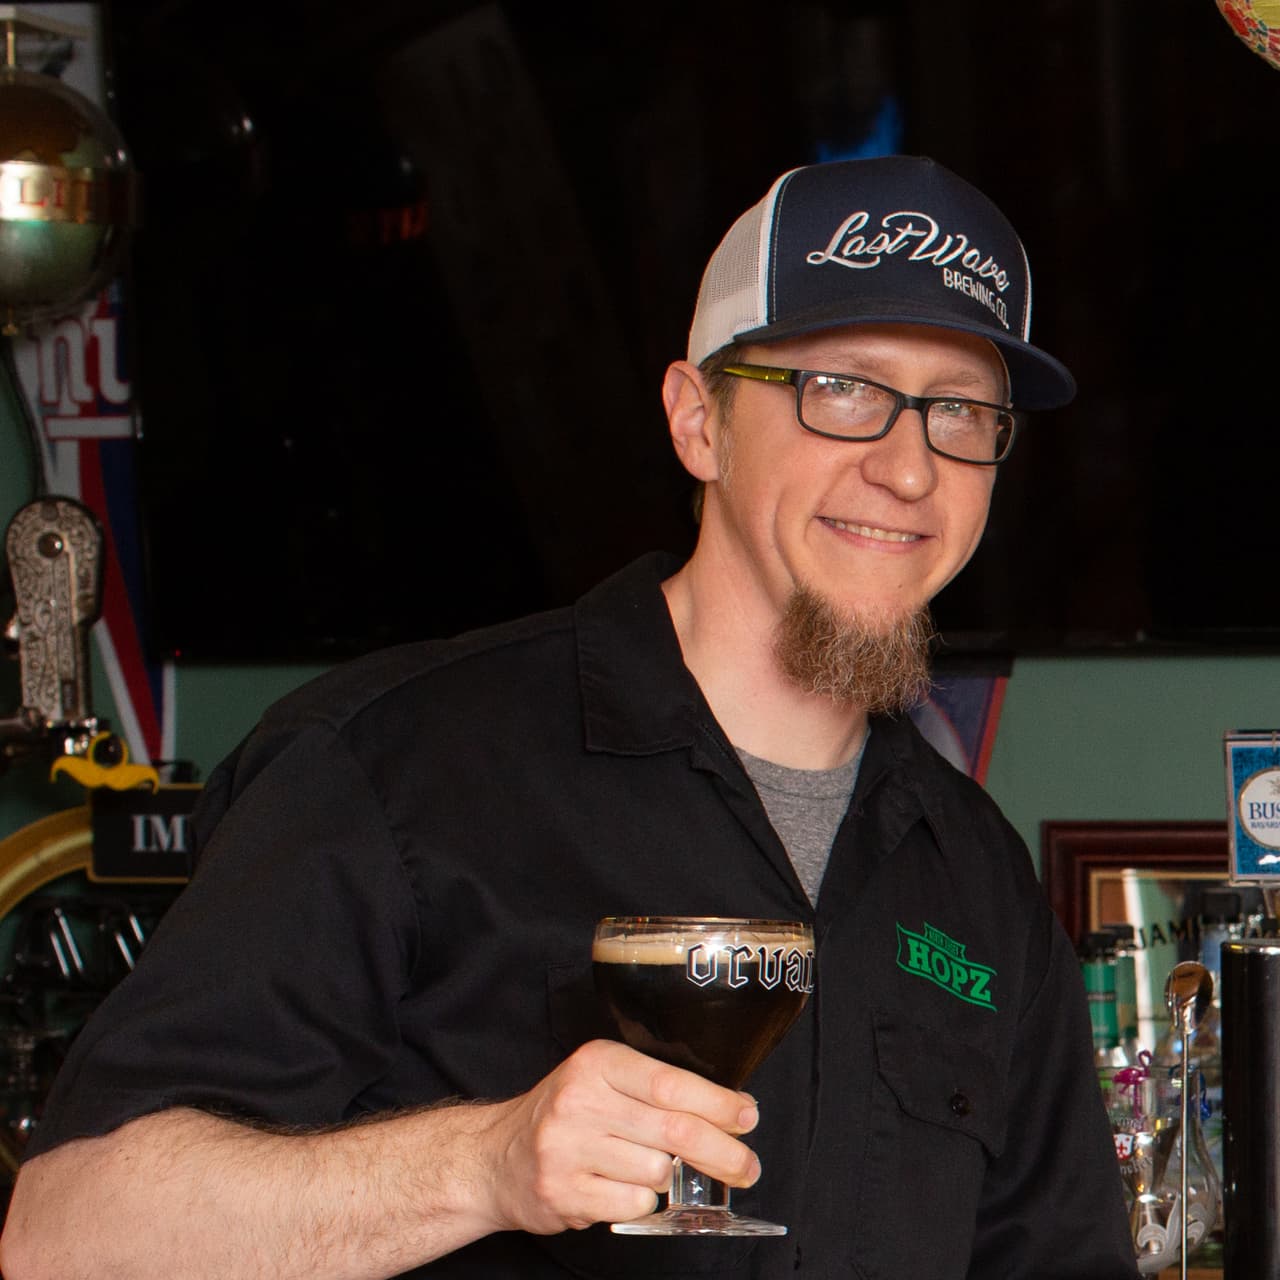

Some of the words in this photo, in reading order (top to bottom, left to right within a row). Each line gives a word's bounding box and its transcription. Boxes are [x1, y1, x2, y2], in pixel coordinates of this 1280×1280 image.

[806, 211, 927, 269] Last
[882, 211, 1010, 292] Wave
[943, 267, 996, 312] BREWING
[907, 938, 992, 1003] HOPZ
